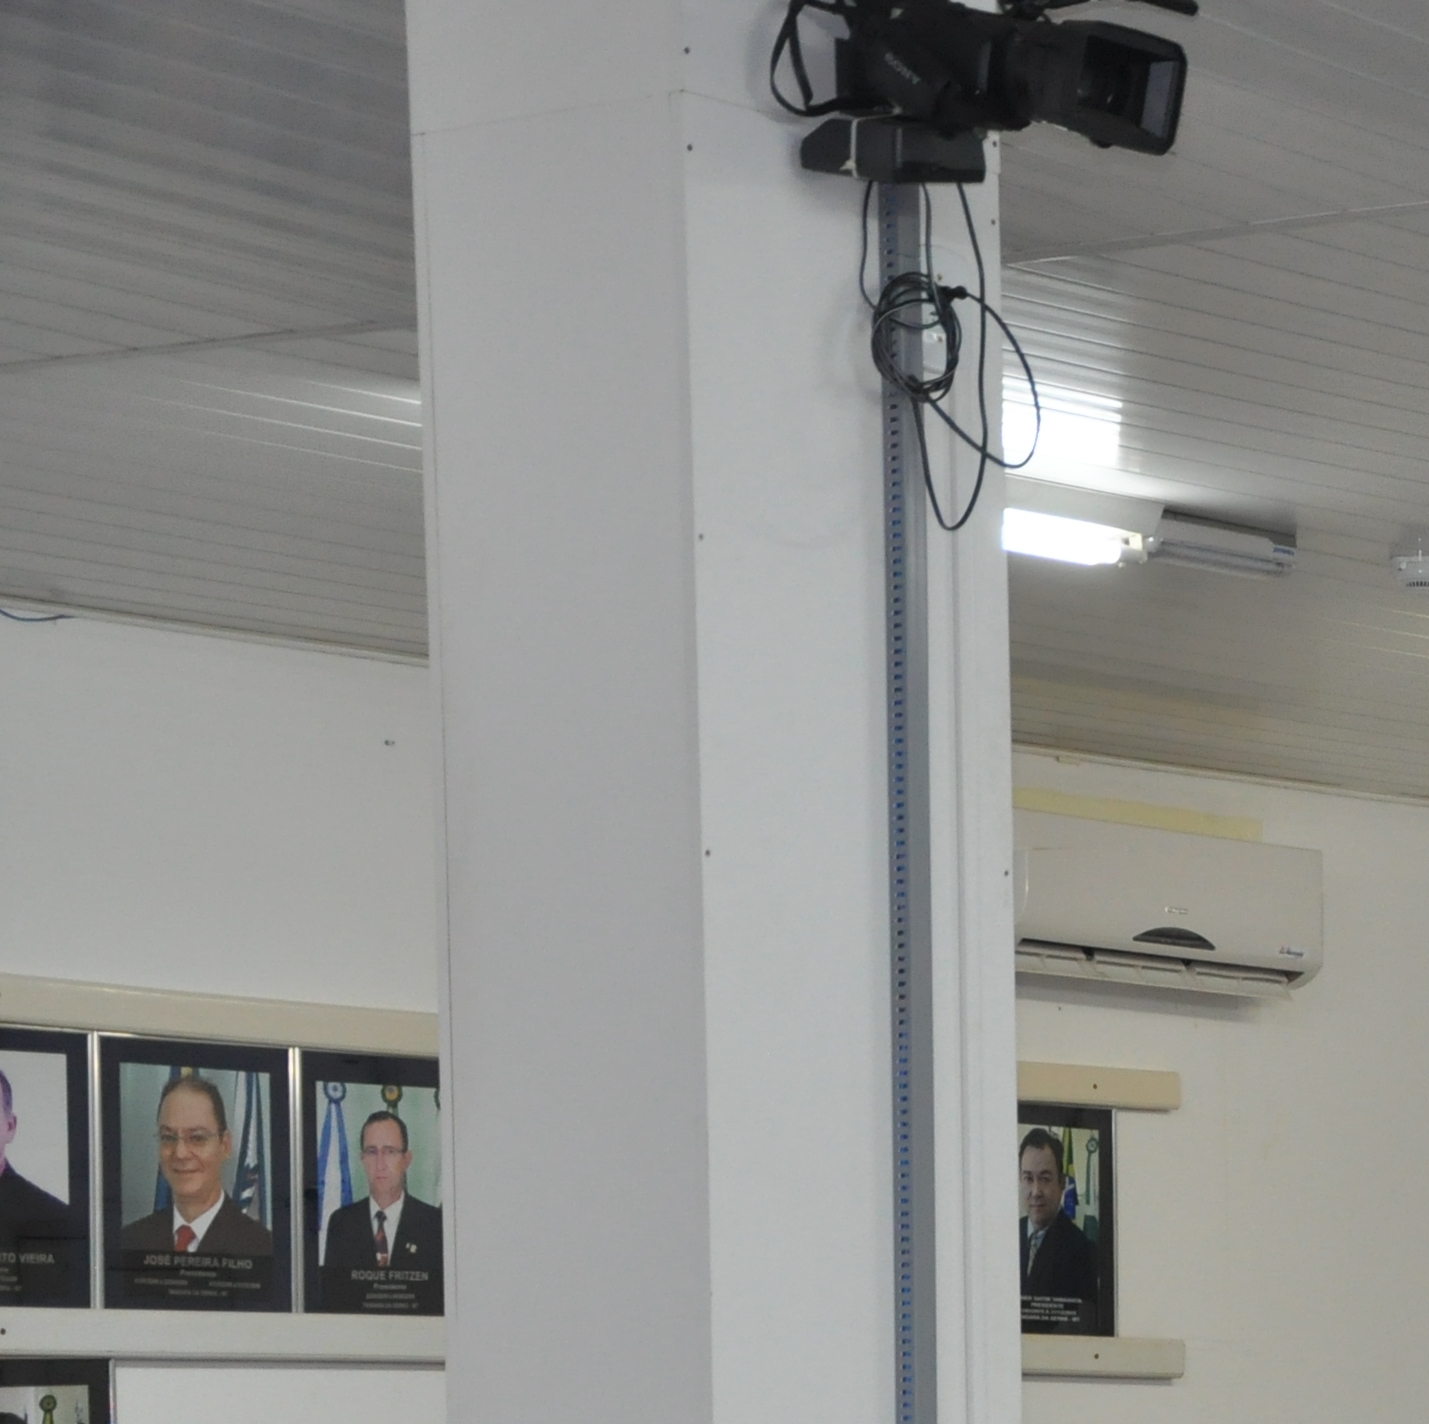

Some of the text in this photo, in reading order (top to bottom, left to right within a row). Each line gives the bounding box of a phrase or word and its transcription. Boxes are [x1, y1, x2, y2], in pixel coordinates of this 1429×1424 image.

[143, 1254, 253, 1270] JOSÉ PEREIRA FILHO
[351, 1270, 429, 1282] ROQUE FRITZEN
